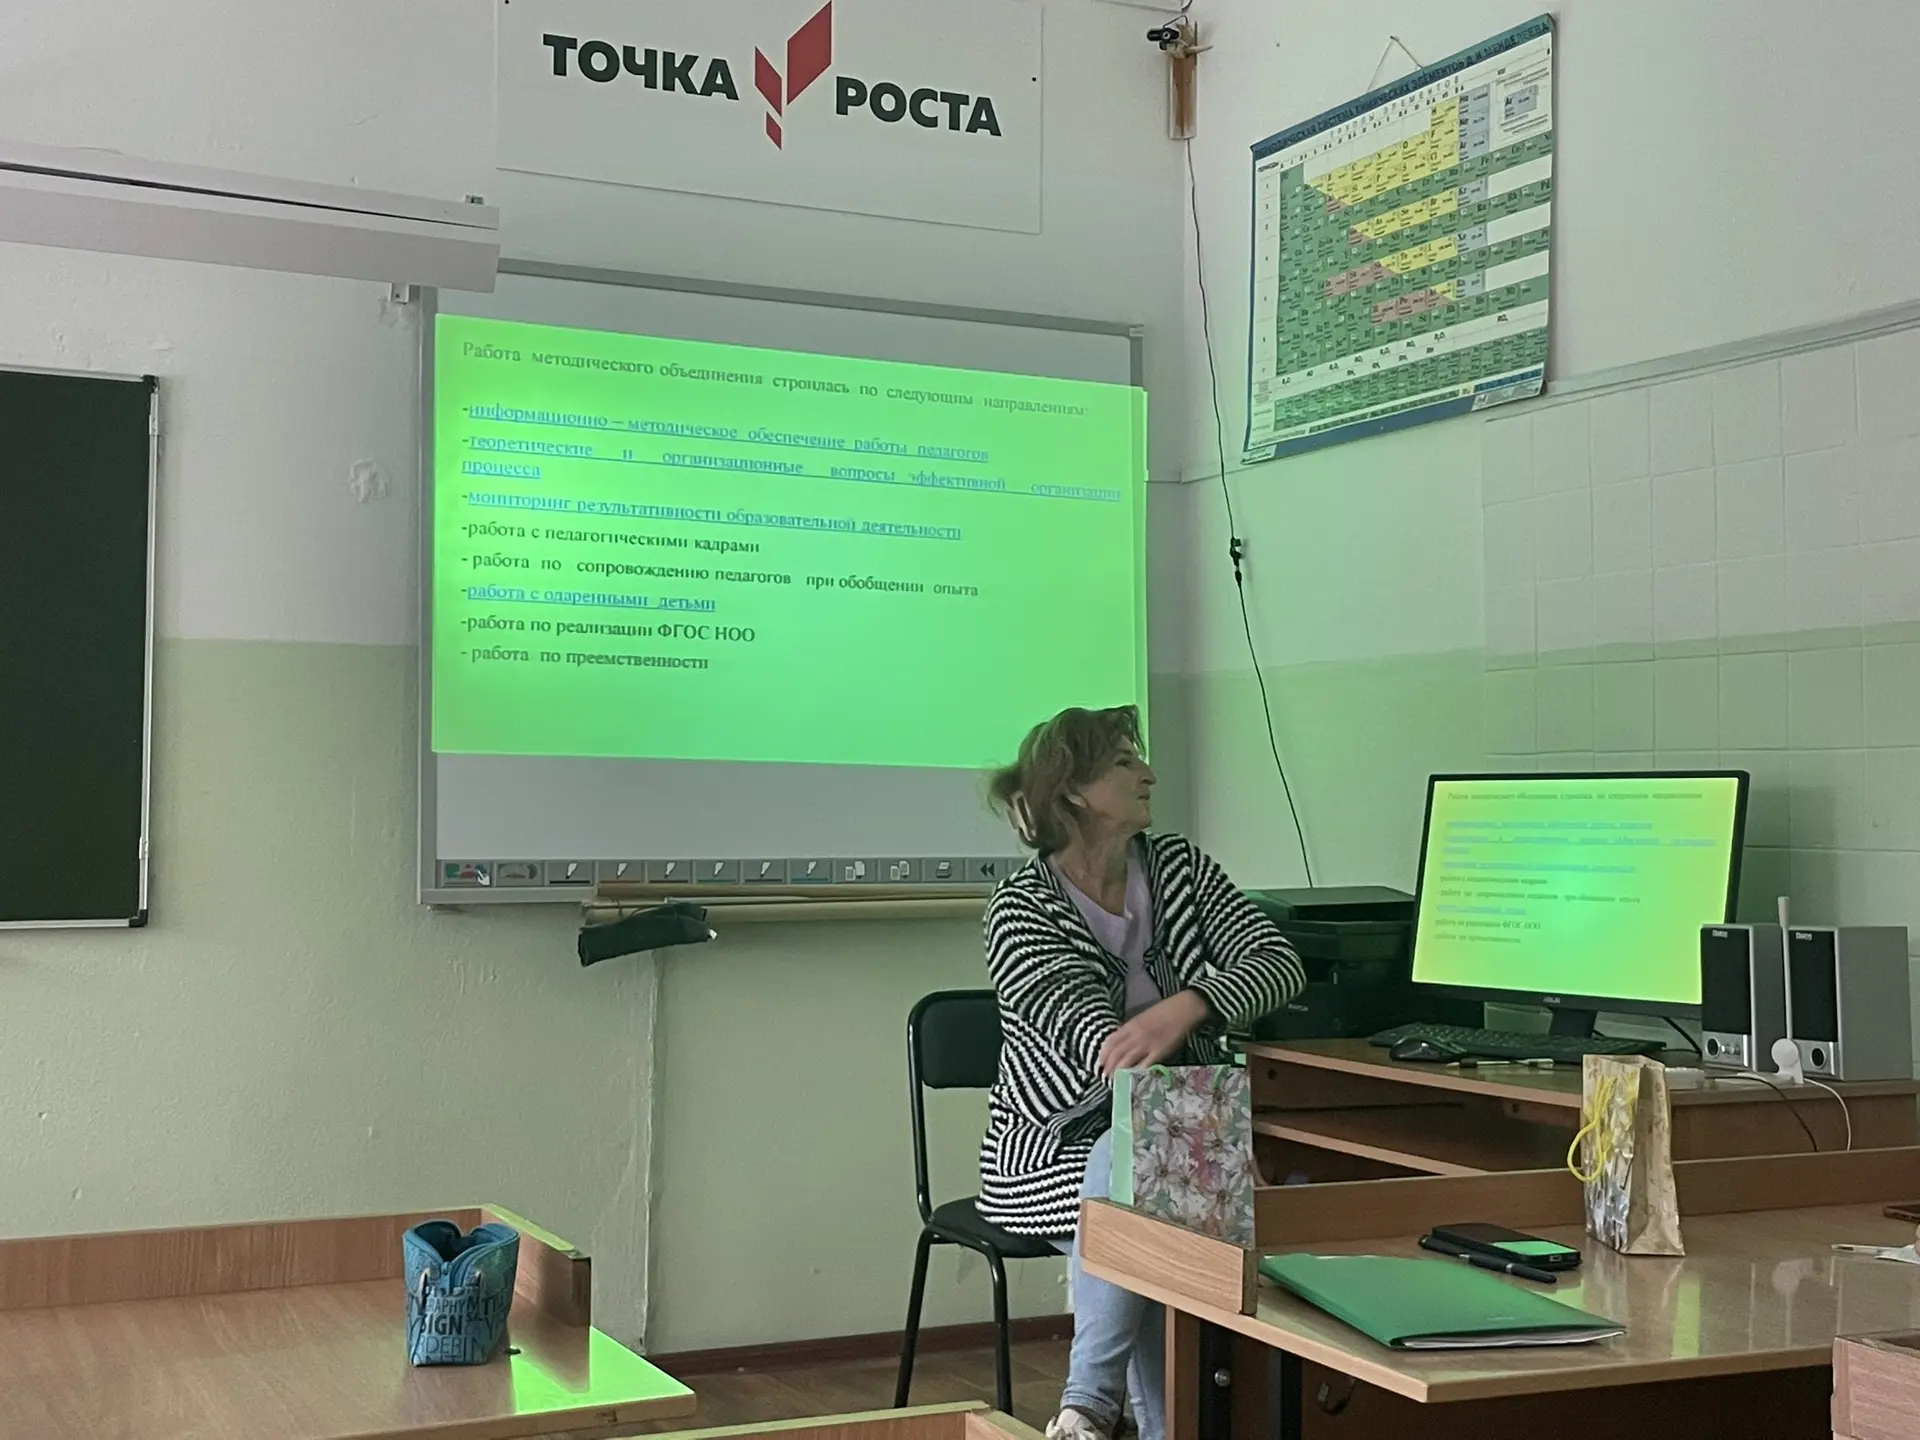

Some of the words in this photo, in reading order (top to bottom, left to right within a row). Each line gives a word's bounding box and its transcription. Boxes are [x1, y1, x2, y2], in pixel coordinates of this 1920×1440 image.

[542, 33, 739, 101] ТОЧКА
[835, 76, 1002, 137] РОСТА
[1318, 108, 1354, 129] СИСТЕМА
[1411, 62, 1464, 89] ЭЛЕМЕНТОВ
[1483, 22, 1549, 58] МЕНДЕЛЕЕВА
[463, 342, 521, 361] Работа
[532, 352, 654, 375] методического
[772, 375, 849, 394] строилась
[859, 384, 878, 397] по
[886, 386, 973, 406] следующим
[628, 418, 737, 439] методическое
[748, 427, 845, 448] обеспечение
[854, 437, 907, 454] работы
[917, 445, 988, 461] педагогов
[462, 459, 541, 477] процесса
[622, 449, 633, 460] и
[662, 452, 803, 474] организационные
[831, 466, 895, 482] вопросы
[908, 471, 1006, 490] эффективной
[577, 499, 721, 521] результативности
[727, 509, 856, 531] образовательной
[861, 520, 961, 539] деятельности
[532, 527, 540, 538] с
[545, 529, 688, 549] педагогическими
[694, 538, 760, 555] кадрами
[473, 552, 529, 569] работа
[541, 559, 561, 571] по
[577, 560, 709, 580] сопровождению
[715, 568, 791, 585] педагогов
[806, 575, 834, 590] при
[839, 575, 924, 594] обобщении
[933, 583, 978, 597] опыта
[531, 590, 538, 600] с
[544, 591, 648, 607] одаренными
[658, 596, 716, 610] детьми
[531, 620, 551, 632] по
[556, 620, 652, 637] реализации
[657, 623, 710, 640] ФГОС
[715, 627, 756, 643] НОО
[472, 645, 529, 662] работа
[540, 652, 561, 663] по
[566, 651, 708, 670] преемственности
